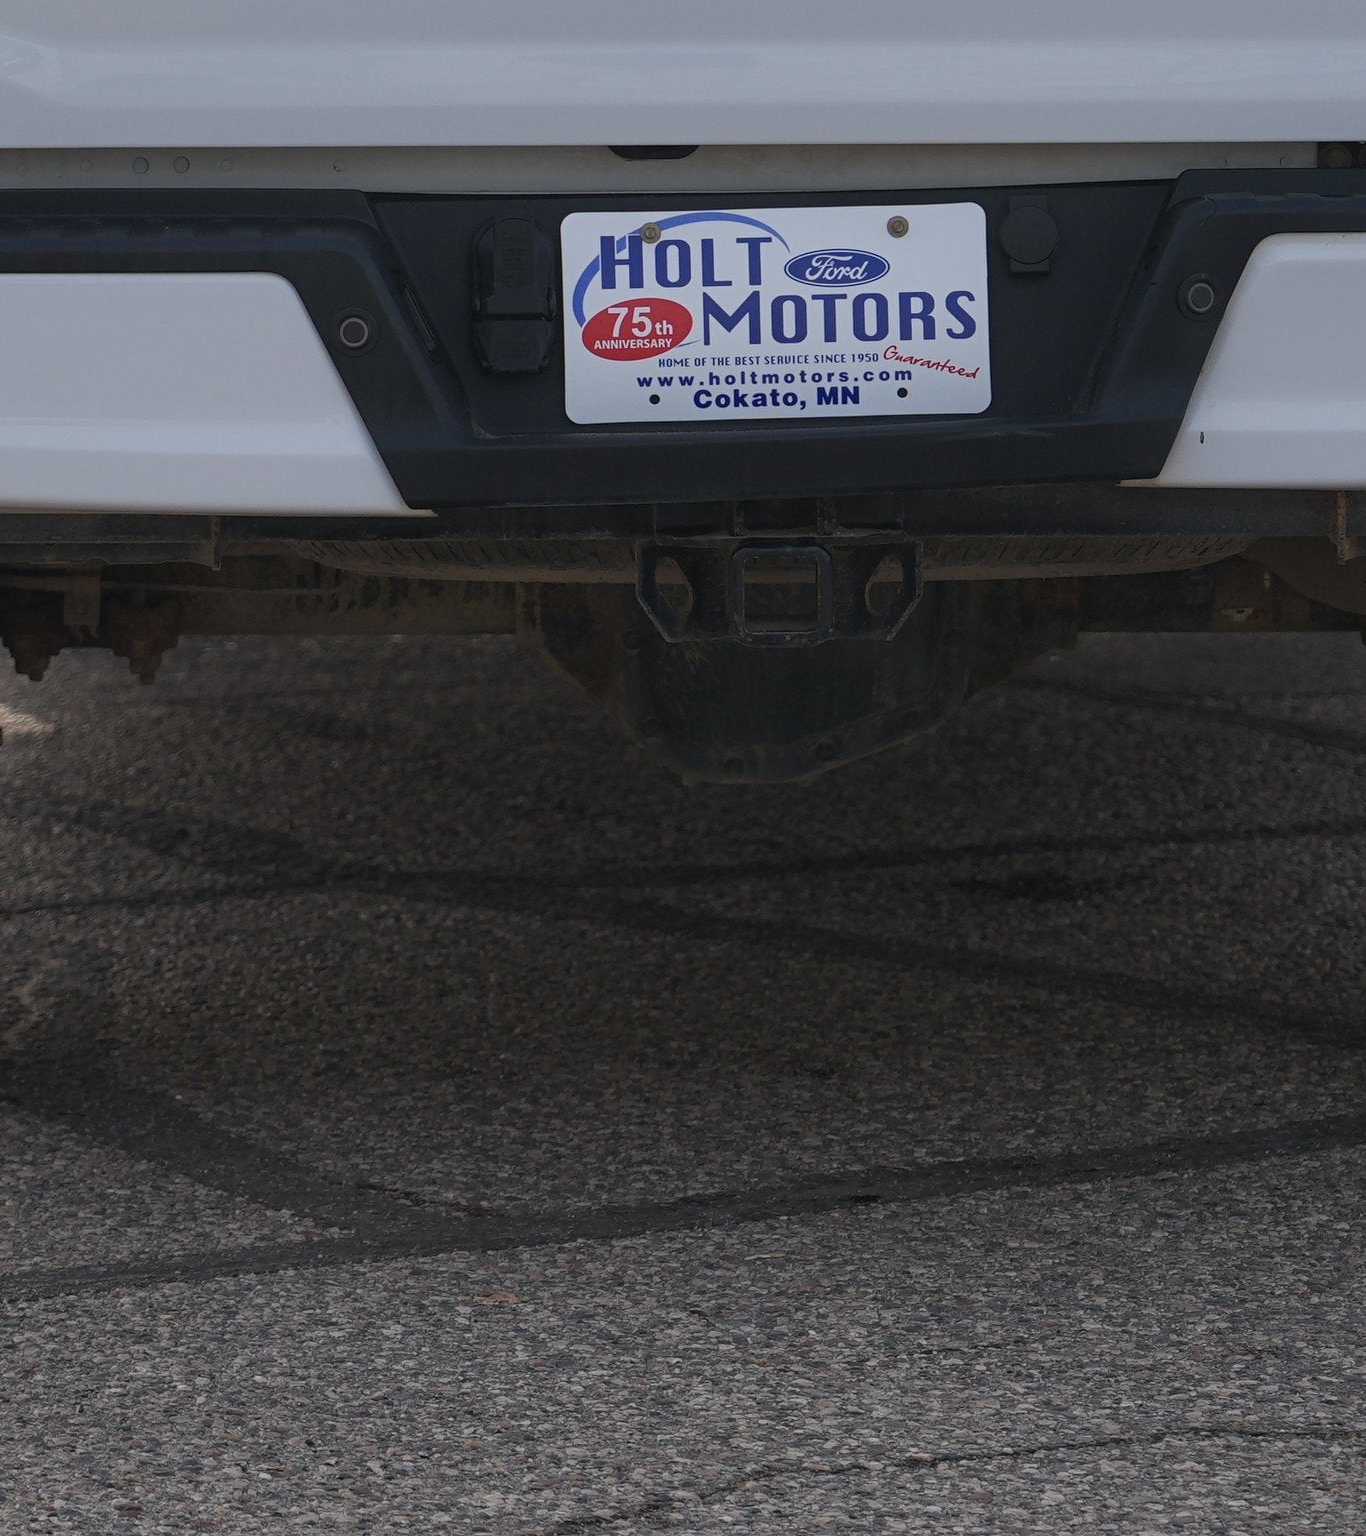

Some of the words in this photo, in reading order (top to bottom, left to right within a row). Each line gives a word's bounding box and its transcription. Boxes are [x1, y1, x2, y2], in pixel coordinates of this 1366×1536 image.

[599, 234, 773, 290] HOLT
[804, 253, 869, 281] Ford
[607, 306, 674, 338] 75th
[702, 289, 977, 346] MOTORS
[593, 338, 673, 350] ANNIVERSARY
[658, 357, 690, 368] HOME
[694, 357, 708, 367] OF
[710, 356, 731, 366] THE
[734, 355, 761, 366] BEST
[764, 354, 810, 365] SERVICE
[813, 353, 847, 364] SINCE
[851, 352, 879, 363] 1950
[883, 345, 981, 379] Guaranteed
[636, 369, 912, 388] www.holtmotors.com
[693, 388, 807, 410] Cokato,
[816, 385, 860, 406] MN
